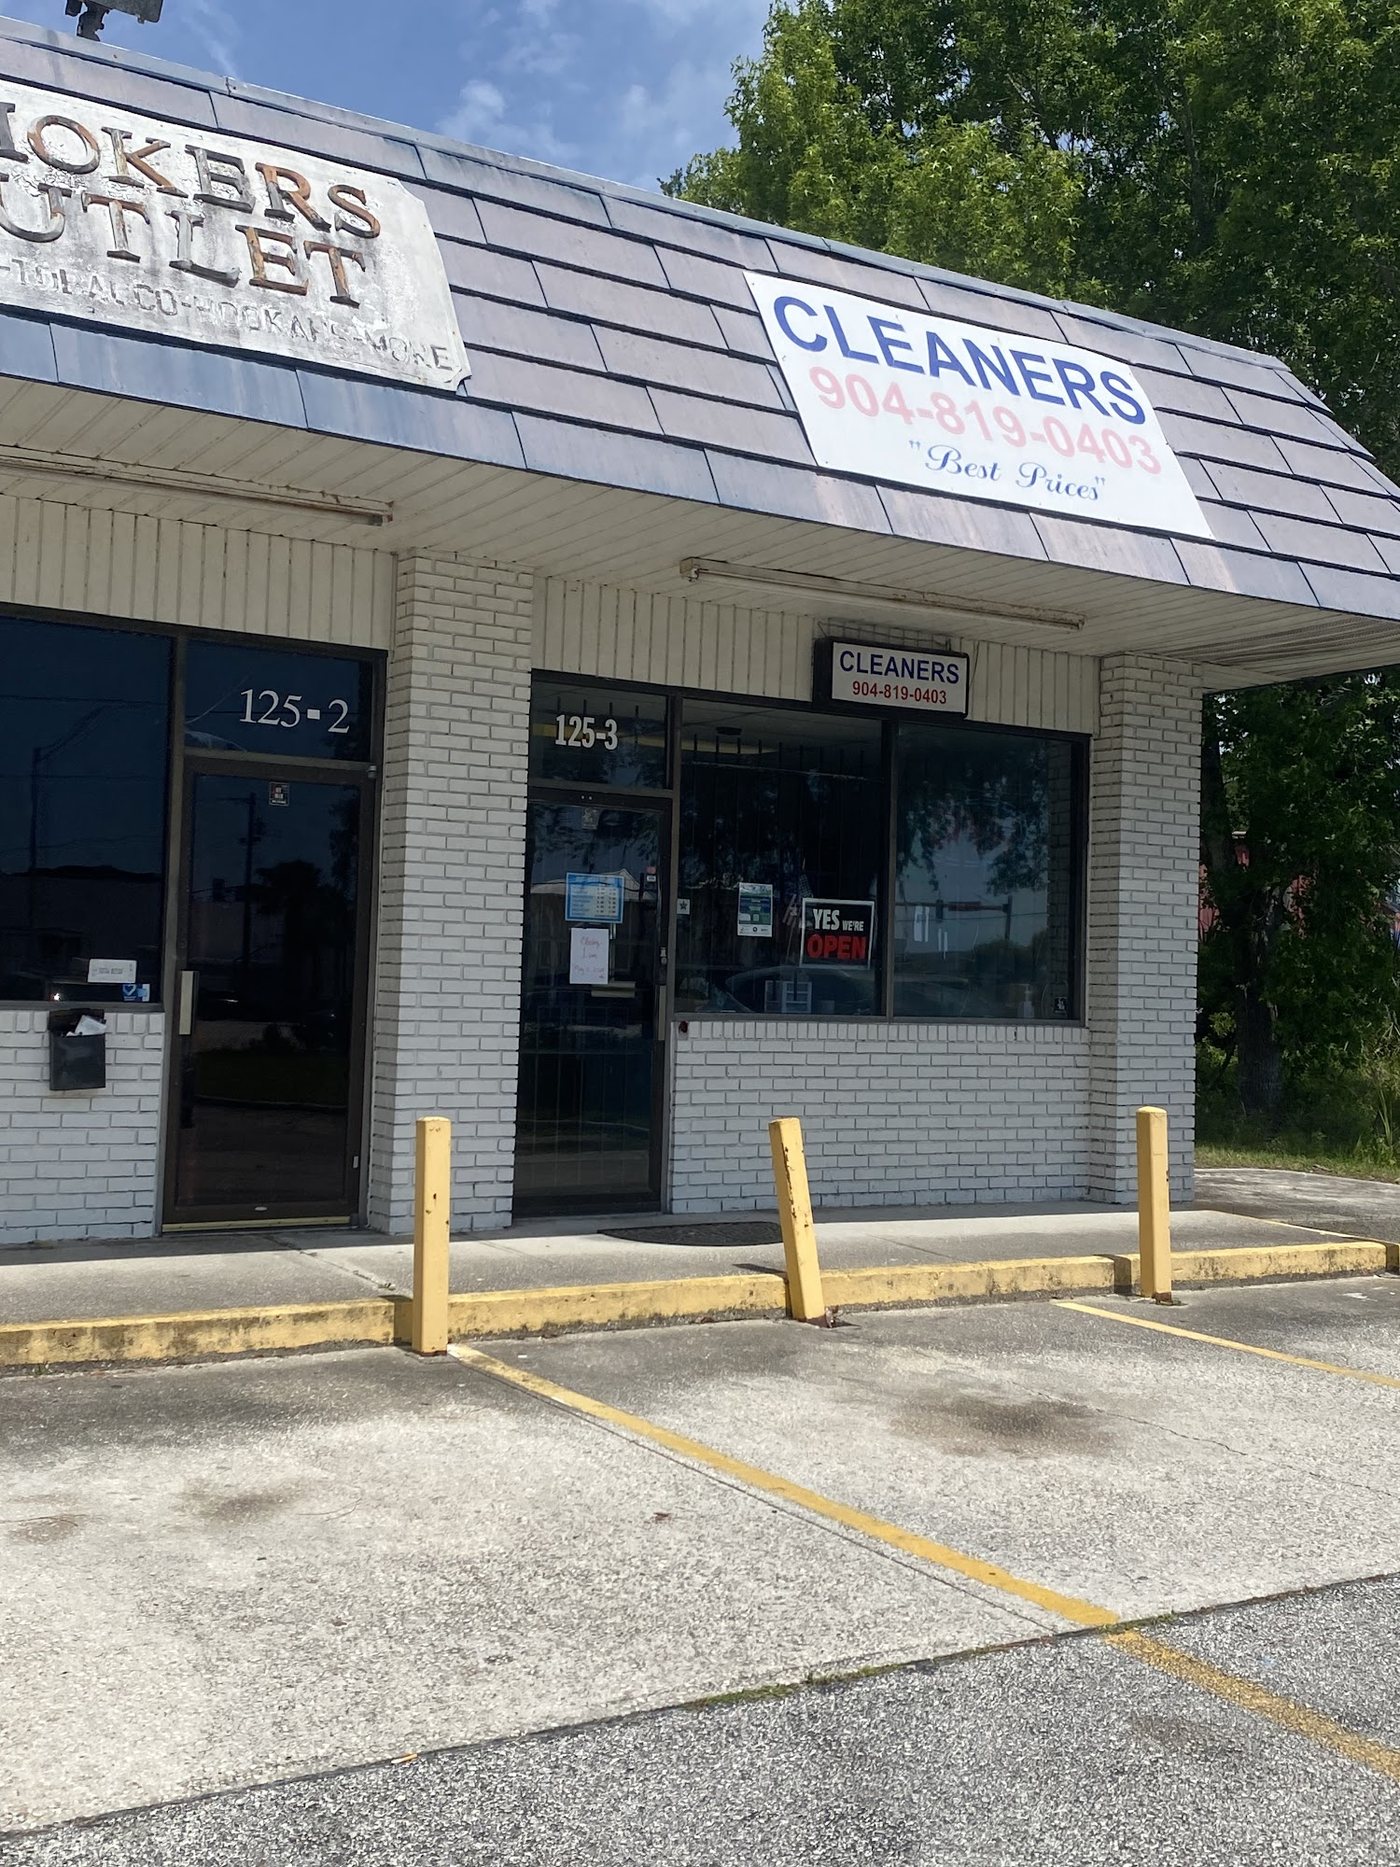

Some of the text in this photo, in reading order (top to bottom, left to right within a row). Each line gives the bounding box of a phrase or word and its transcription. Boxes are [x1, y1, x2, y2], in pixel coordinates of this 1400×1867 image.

[773, 295, 1147, 425] CLEANERS
[809, 366, 1162, 475] 904-819-0403
[908, 439, 1106, 501] "Best Prices"
[839, 650, 960, 685] CLEANERS
[240, 688, 350, 734] 125-2
[852, 680, 947, 705] 904-819-0403
[555, 714, 619, 751] 125-3
[812, 908, 865, 932] YES WE'RE
[806, 933, 868, 961] OPEN
